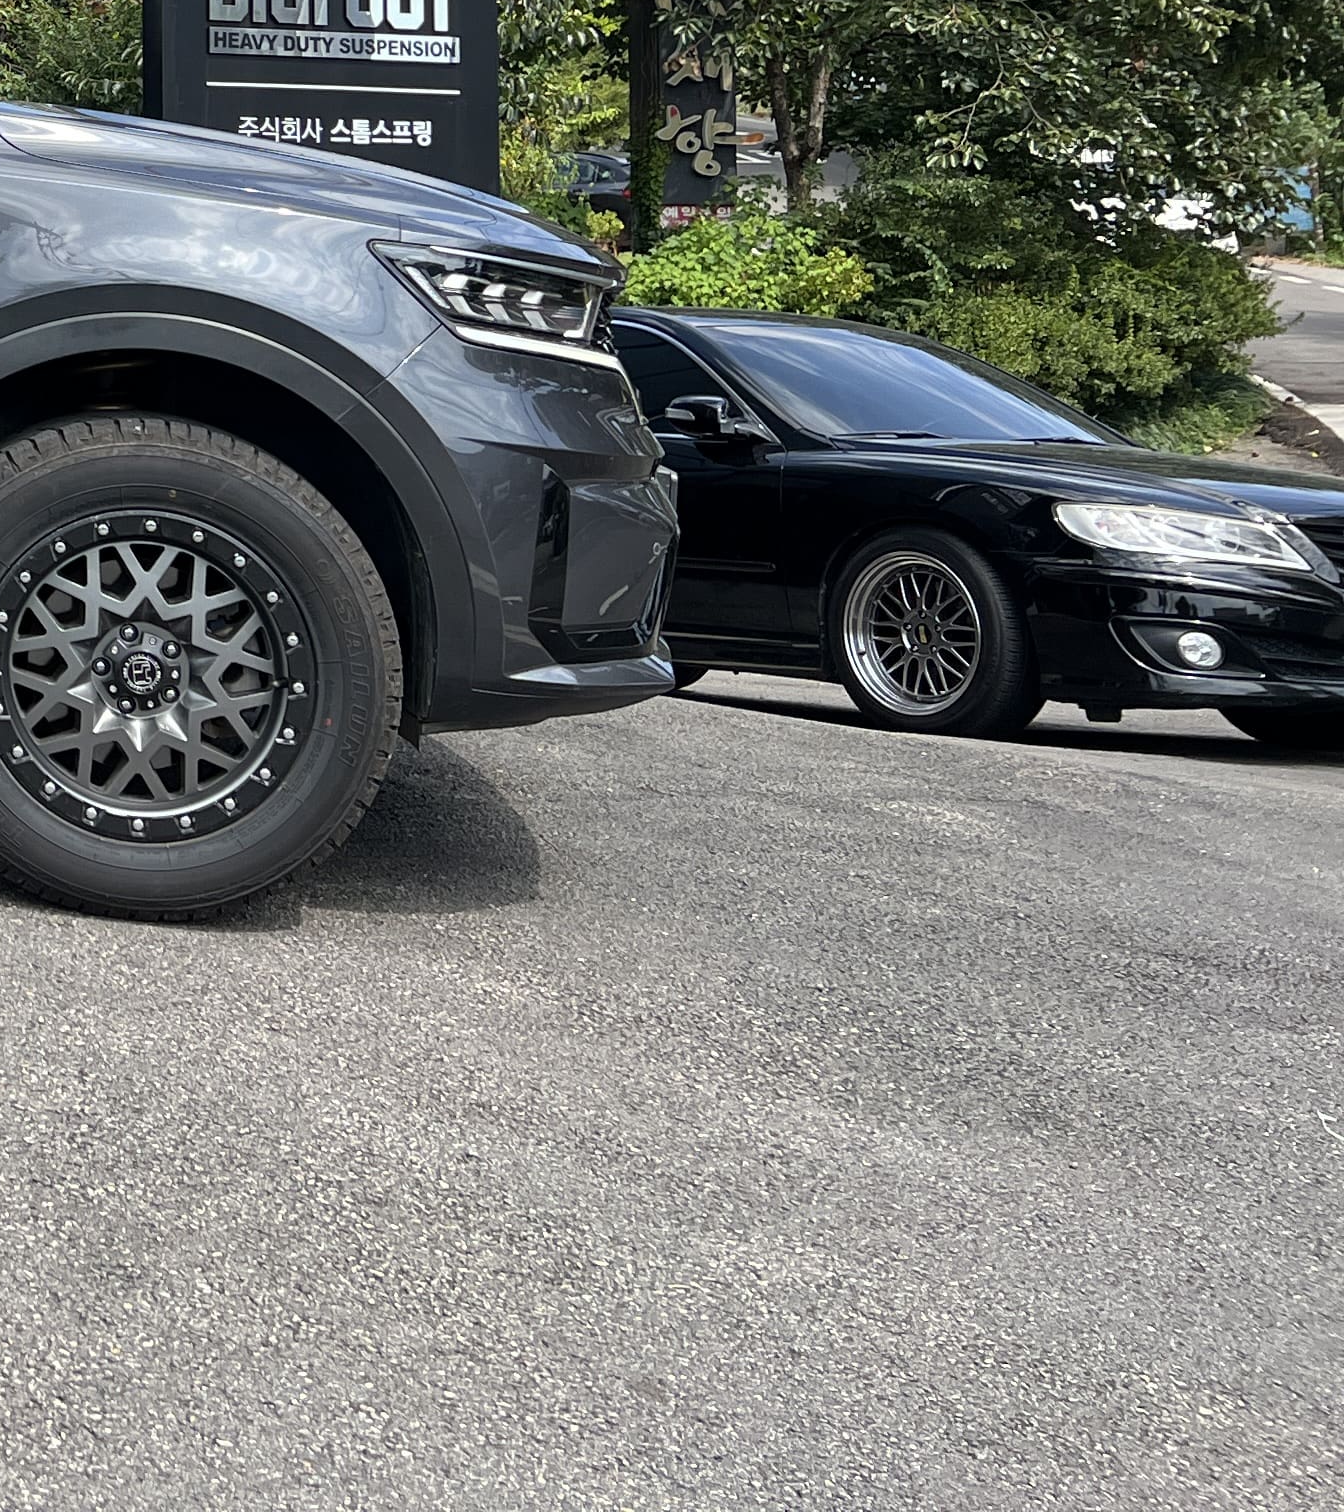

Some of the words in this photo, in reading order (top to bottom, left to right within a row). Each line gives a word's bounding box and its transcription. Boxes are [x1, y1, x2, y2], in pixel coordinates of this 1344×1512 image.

[213, 31, 278, 51] HEAVY
[283, 35, 334, 53] DUTY
[338, 39, 457, 58] SUSPENSION
[238, 116, 323, 144] 주식회사
[329, 118, 433, 147] 스톰스프링
[662, 205, 731, 218] 예약의
[333, 595, 370, 768] SAILUN
